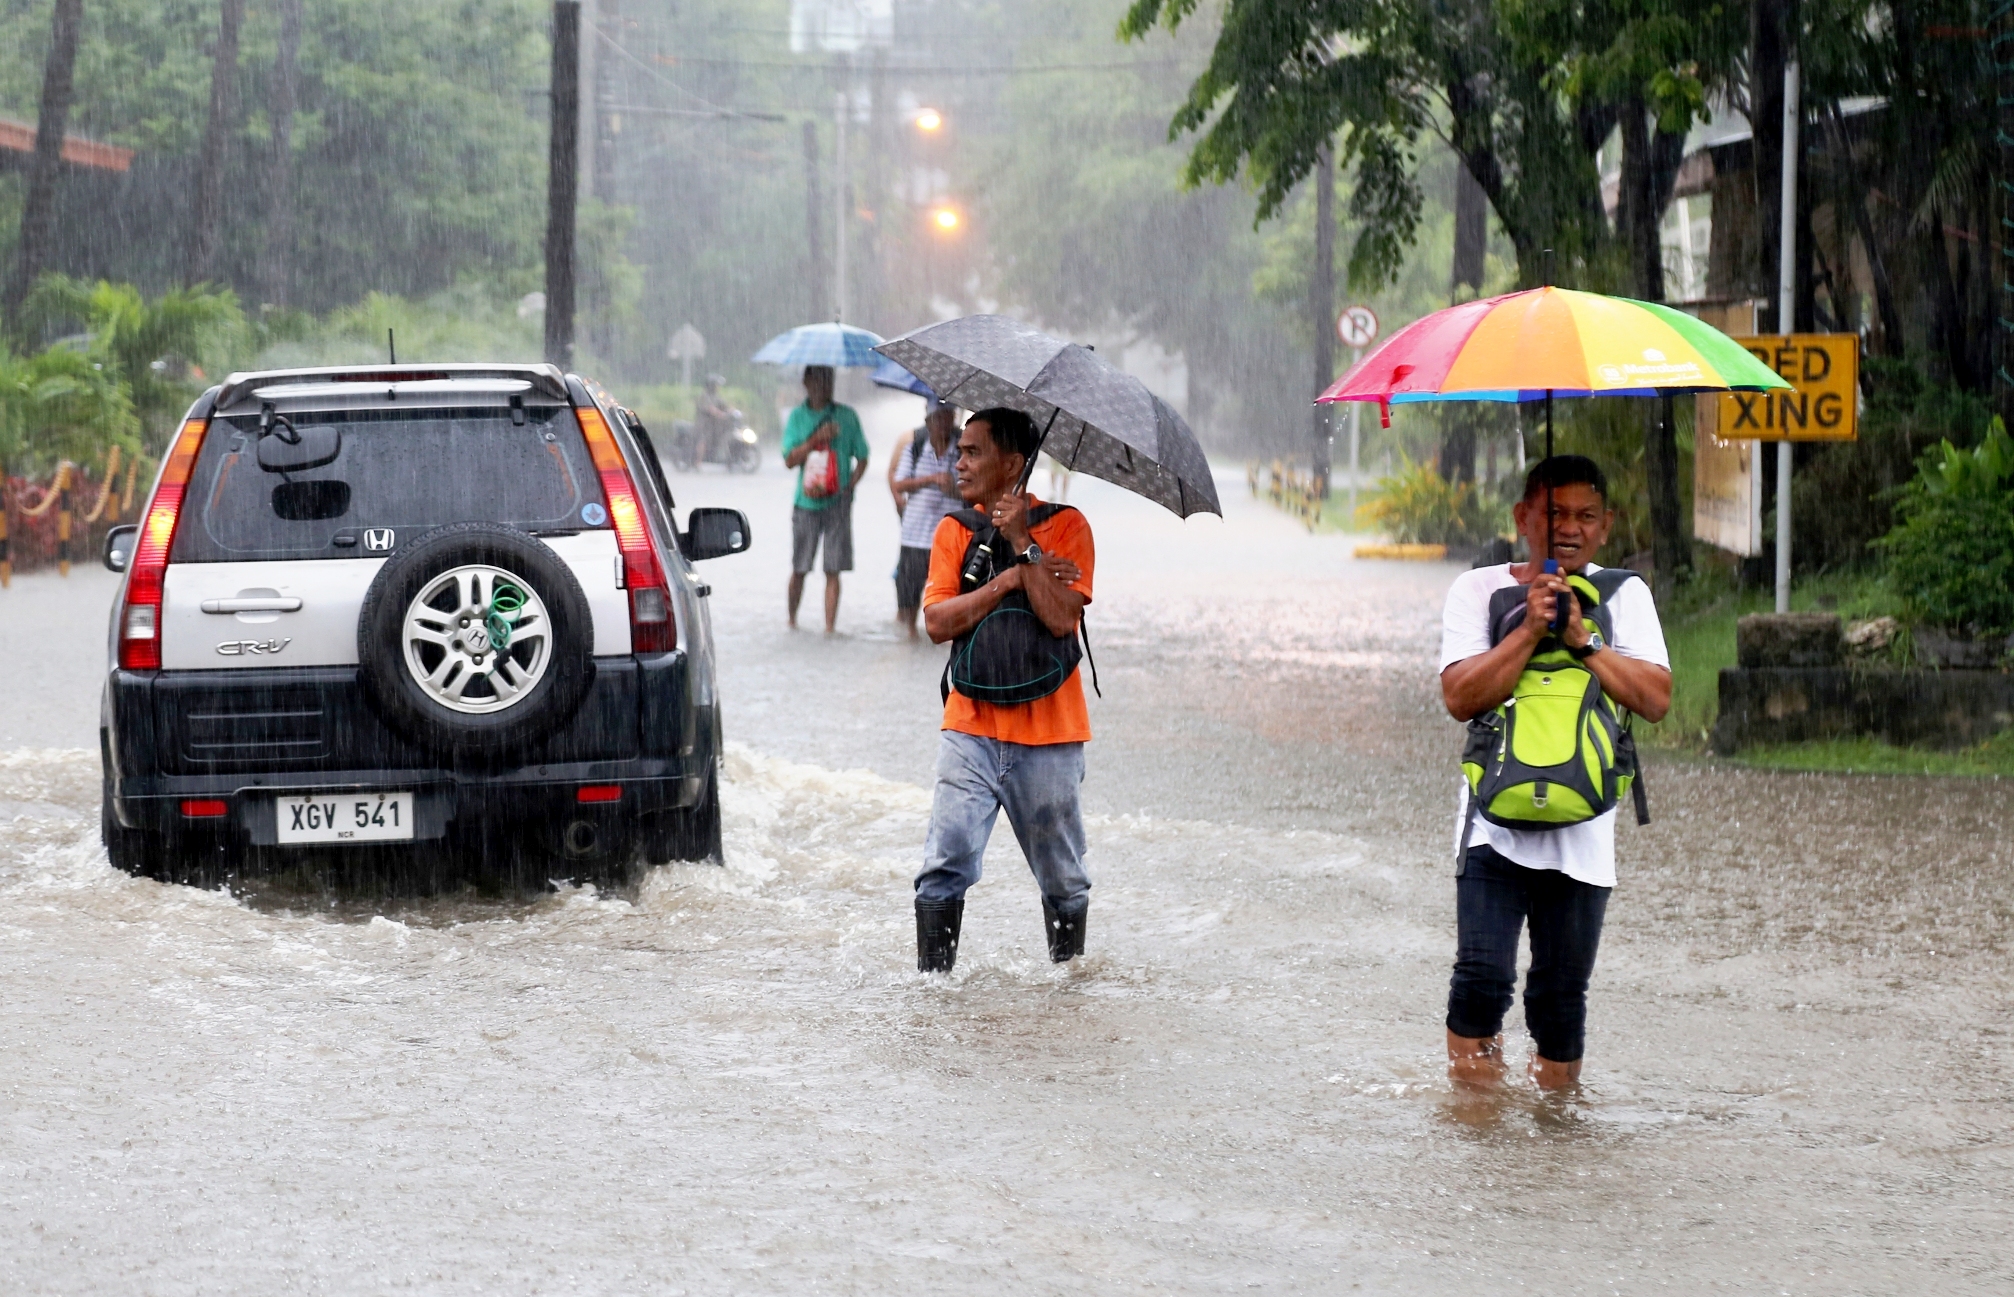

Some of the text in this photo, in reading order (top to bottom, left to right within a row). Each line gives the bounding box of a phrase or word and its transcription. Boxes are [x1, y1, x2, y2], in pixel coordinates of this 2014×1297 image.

[1351, 313, 1368, 340] P
[1622, 361, 1700, 374] Metrobank
[1733, 391, 1843, 430] XING
[215, 637, 292, 656] CR-V
[290, 800, 400, 831] XGV 541
[337, 830, 355, 839] NCR
